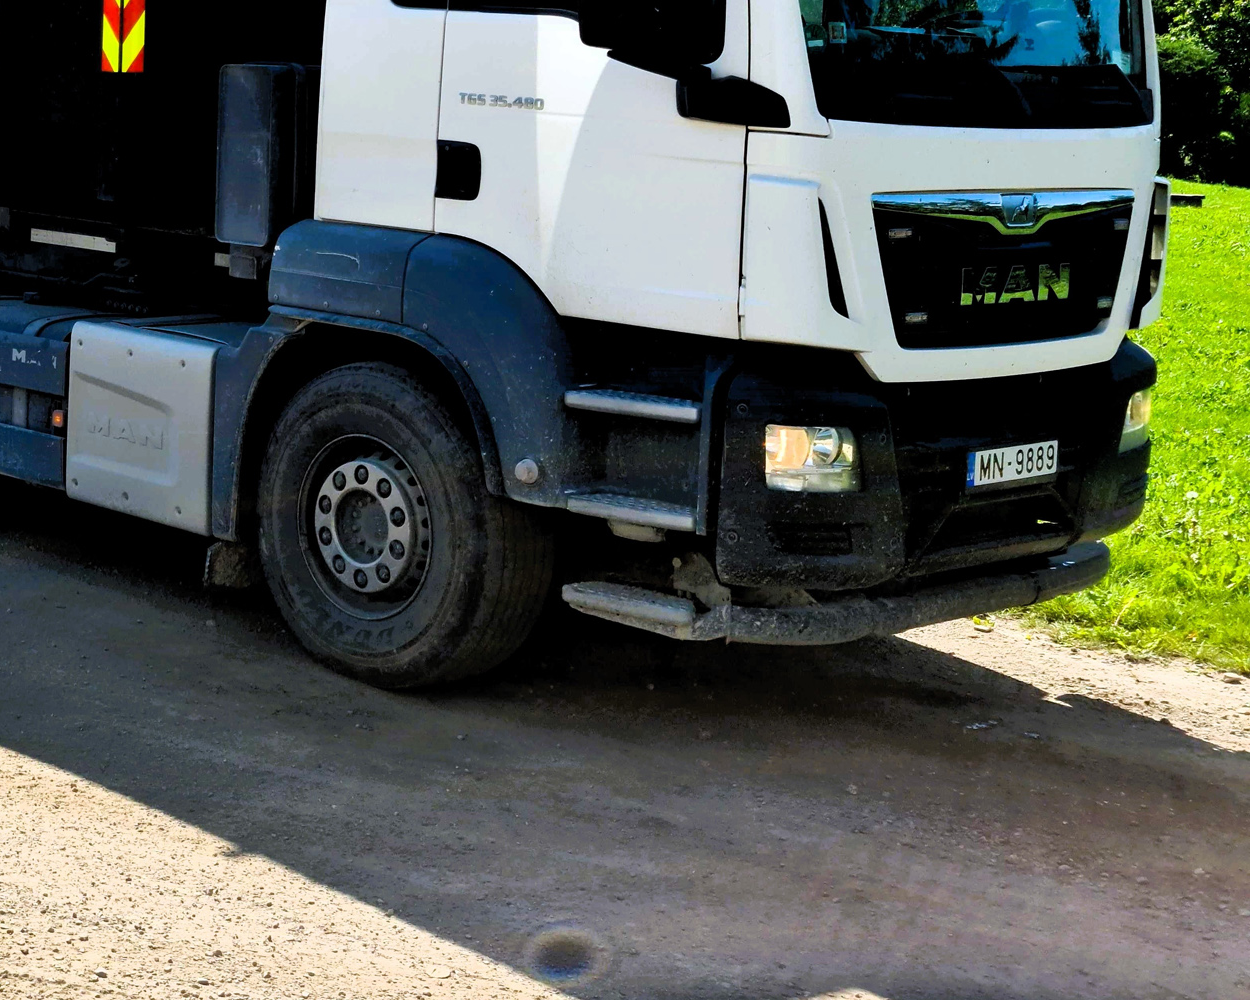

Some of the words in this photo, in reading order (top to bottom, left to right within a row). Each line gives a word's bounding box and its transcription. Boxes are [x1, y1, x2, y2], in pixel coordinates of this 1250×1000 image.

[459, 92, 486, 106] TGS
[489, 94, 545, 111] 35.480
[960, 262, 1070, 306] MAN
[979, 444, 1055, 481] MN-9889
